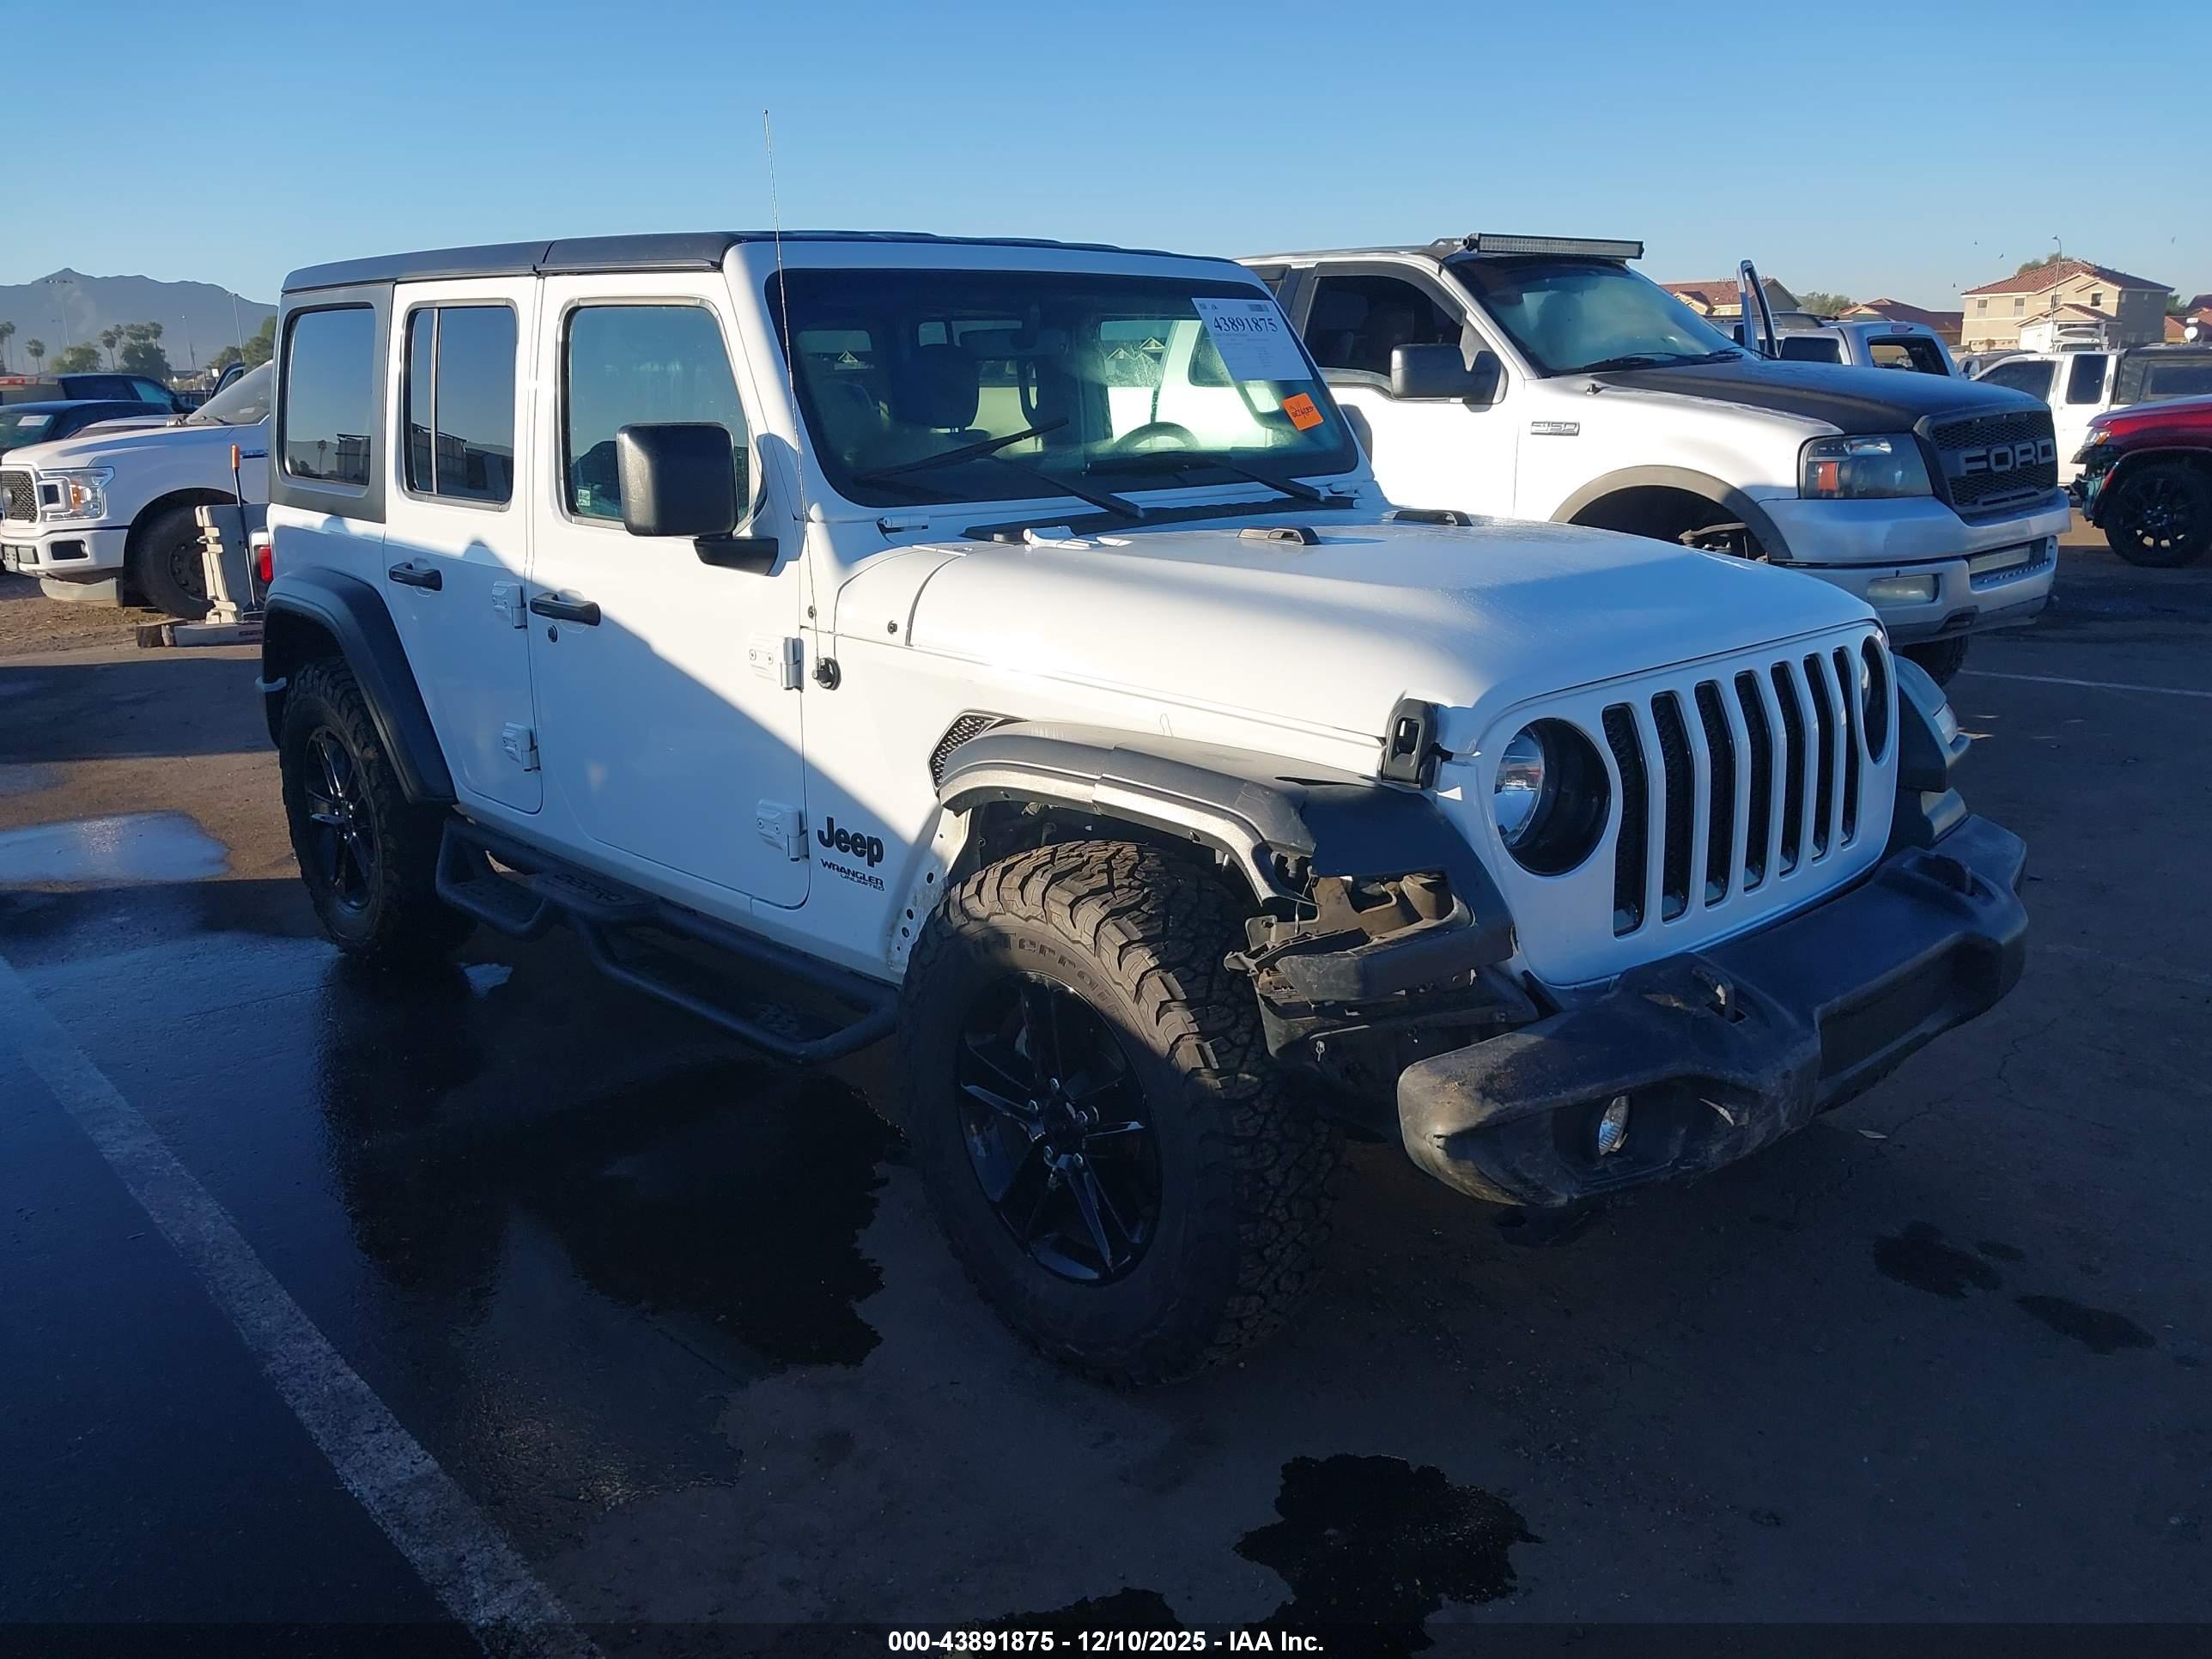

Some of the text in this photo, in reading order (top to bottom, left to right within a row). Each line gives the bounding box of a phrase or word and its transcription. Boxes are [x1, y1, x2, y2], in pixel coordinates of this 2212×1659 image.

[1213, 316, 1279, 332] 43891875
[1959, 438, 2056, 476] FORD
[817, 816, 884, 868] Jeep
[820, 858, 884, 888] WRANGLER
[839, 872, 885, 891] UNLIMITED
